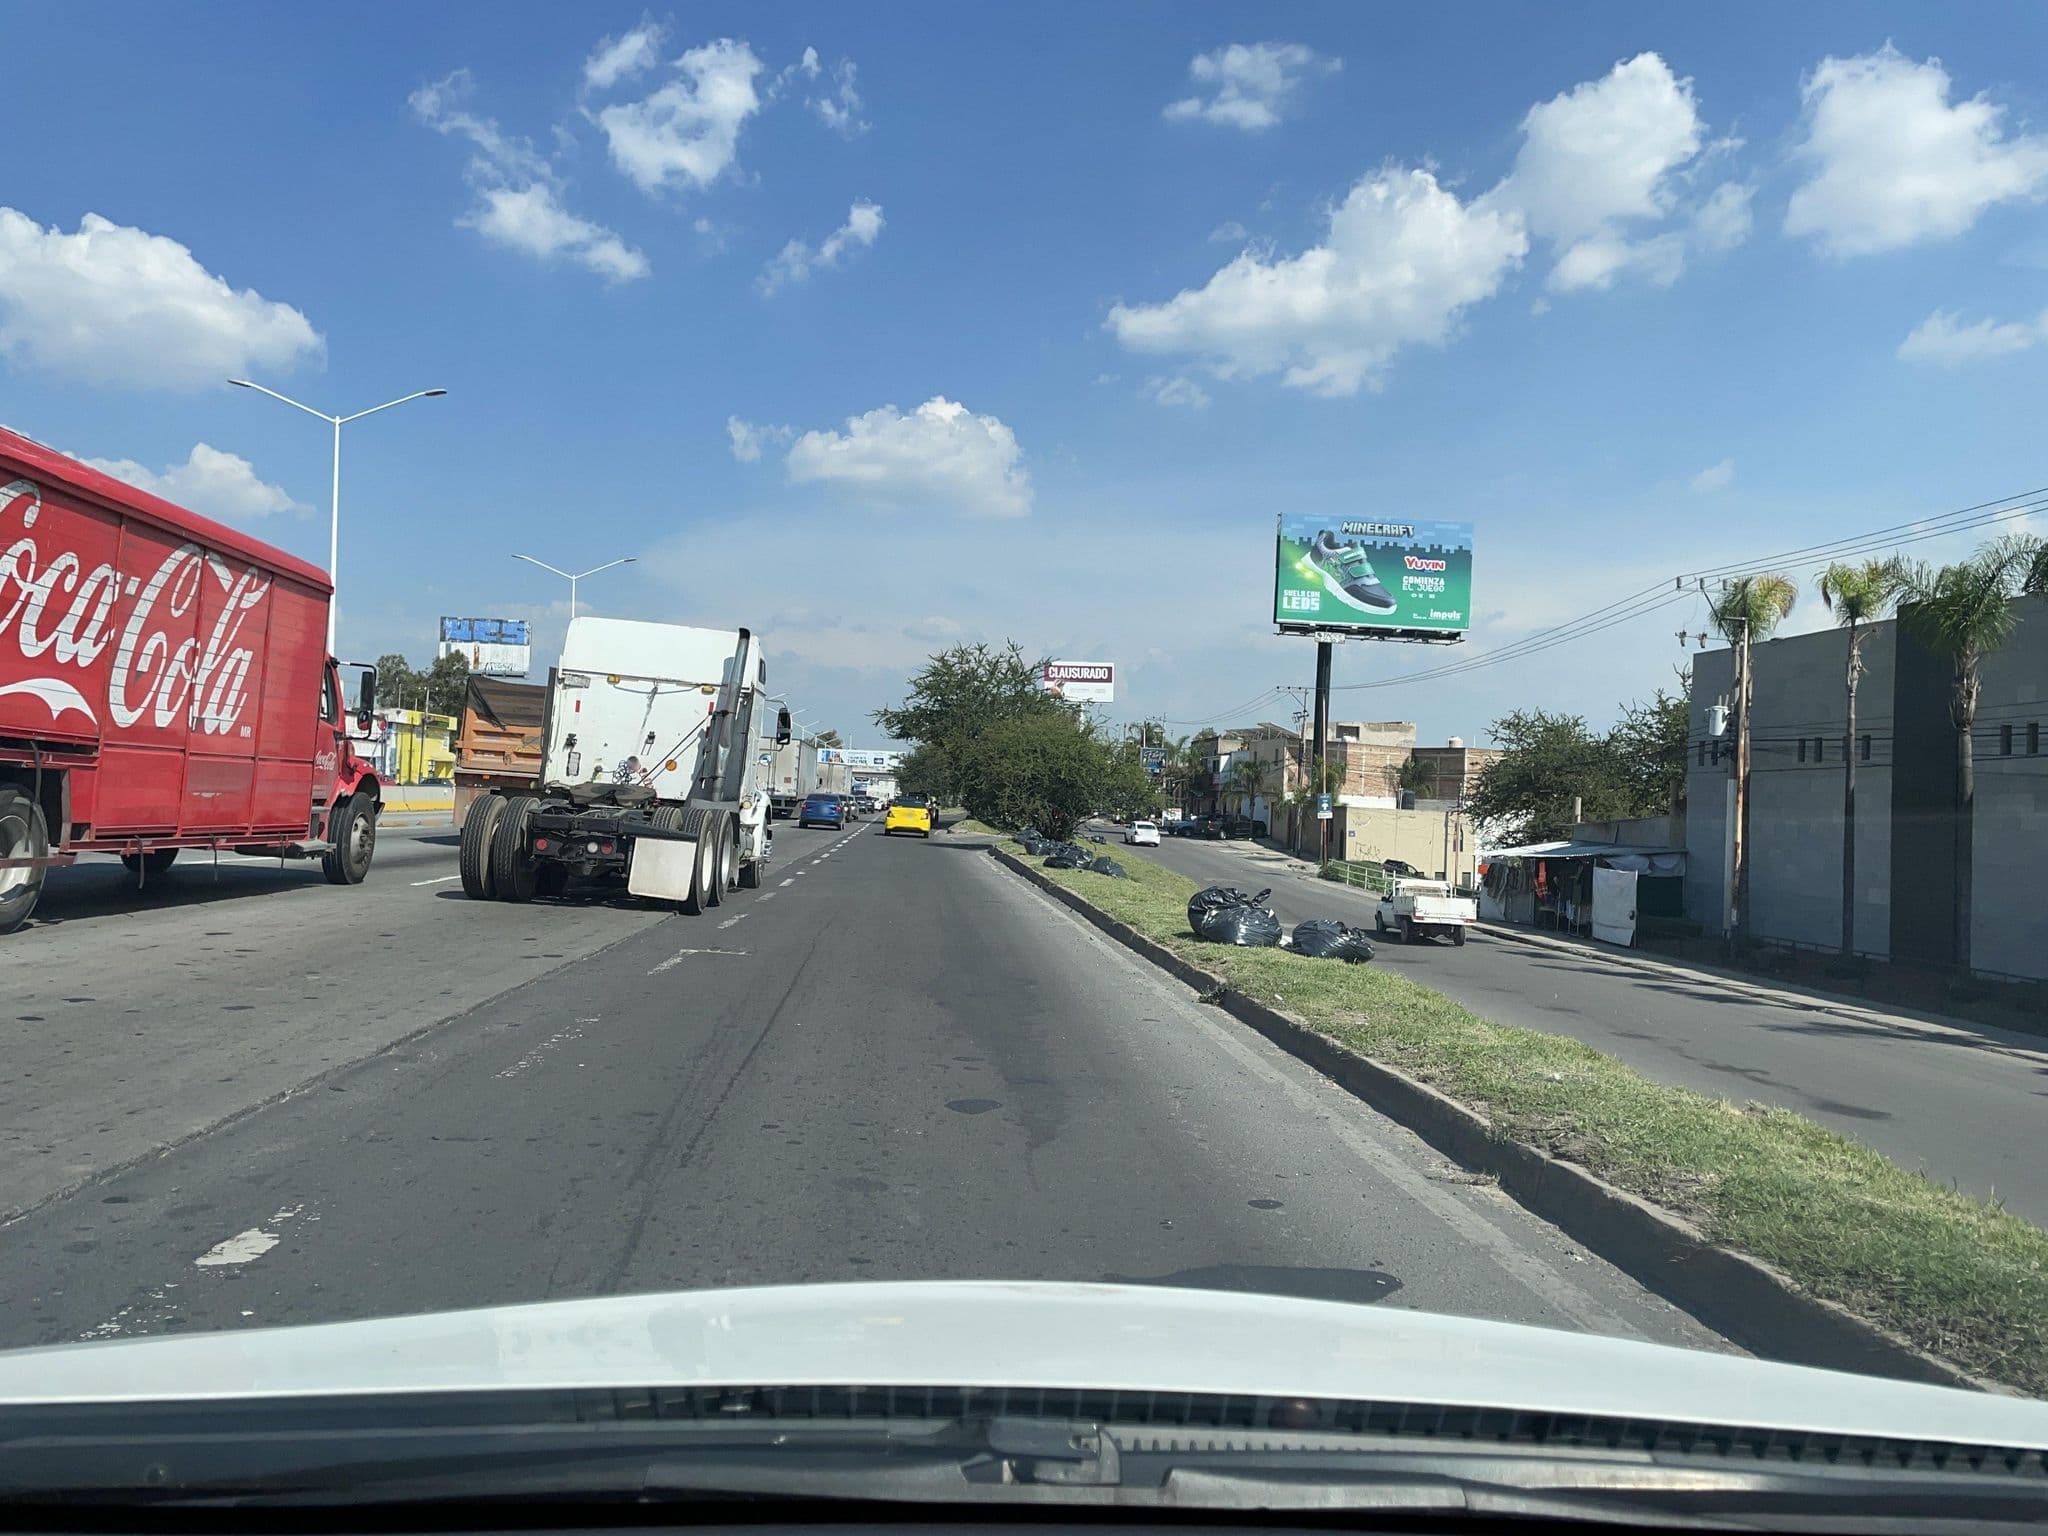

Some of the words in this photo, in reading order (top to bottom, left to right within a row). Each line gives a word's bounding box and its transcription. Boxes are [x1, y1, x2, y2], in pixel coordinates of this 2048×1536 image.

[1341, 521, 1415, 538] MINECRAFT
[1404, 556, 1445, 571] YUYIN
[1403, 576, 1445, 585] COMIENZA
[1417, 584, 1445, 592] JUEGO
[1282, 597, 1320, 611] LEDS
[1048, 666, 1108, 679] CLAUSURADO
[240, 725, 251, 738] MR
